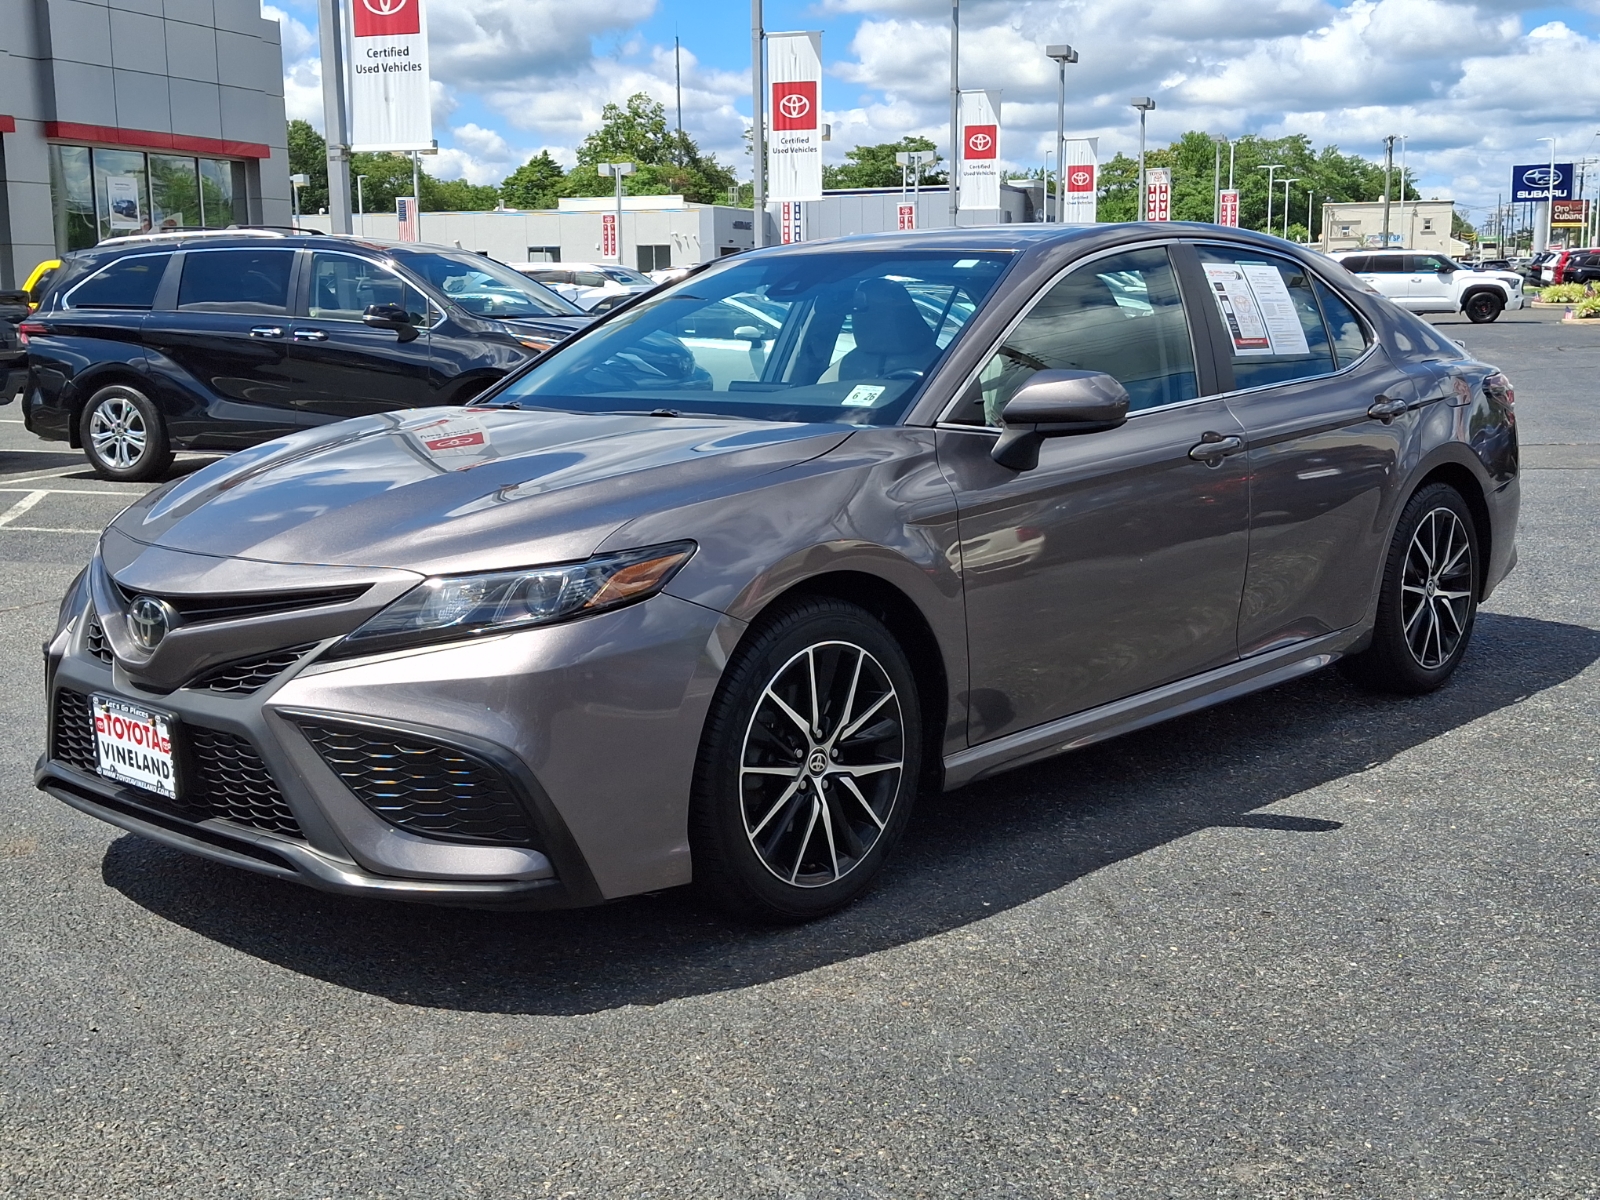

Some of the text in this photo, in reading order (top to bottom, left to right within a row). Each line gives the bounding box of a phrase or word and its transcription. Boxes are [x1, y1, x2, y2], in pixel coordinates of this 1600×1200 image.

[366, 45, 410, 58] Certified
[355, 60, 422, 74] Used Vehicles
[780, 136, 810, 145] Certified
[1516, 189, 1568, 199] SUBARU
[1554, 205, 1570, 214] Oro
[1554, 212, 1584, 220] Cubano
[852, 391, 860, 399] 6
[105, 700, 149, 719] Let's Go Places
[104, 713, 162, 752] TOYOTA
[101, 740, 170, 780] VINELAND
